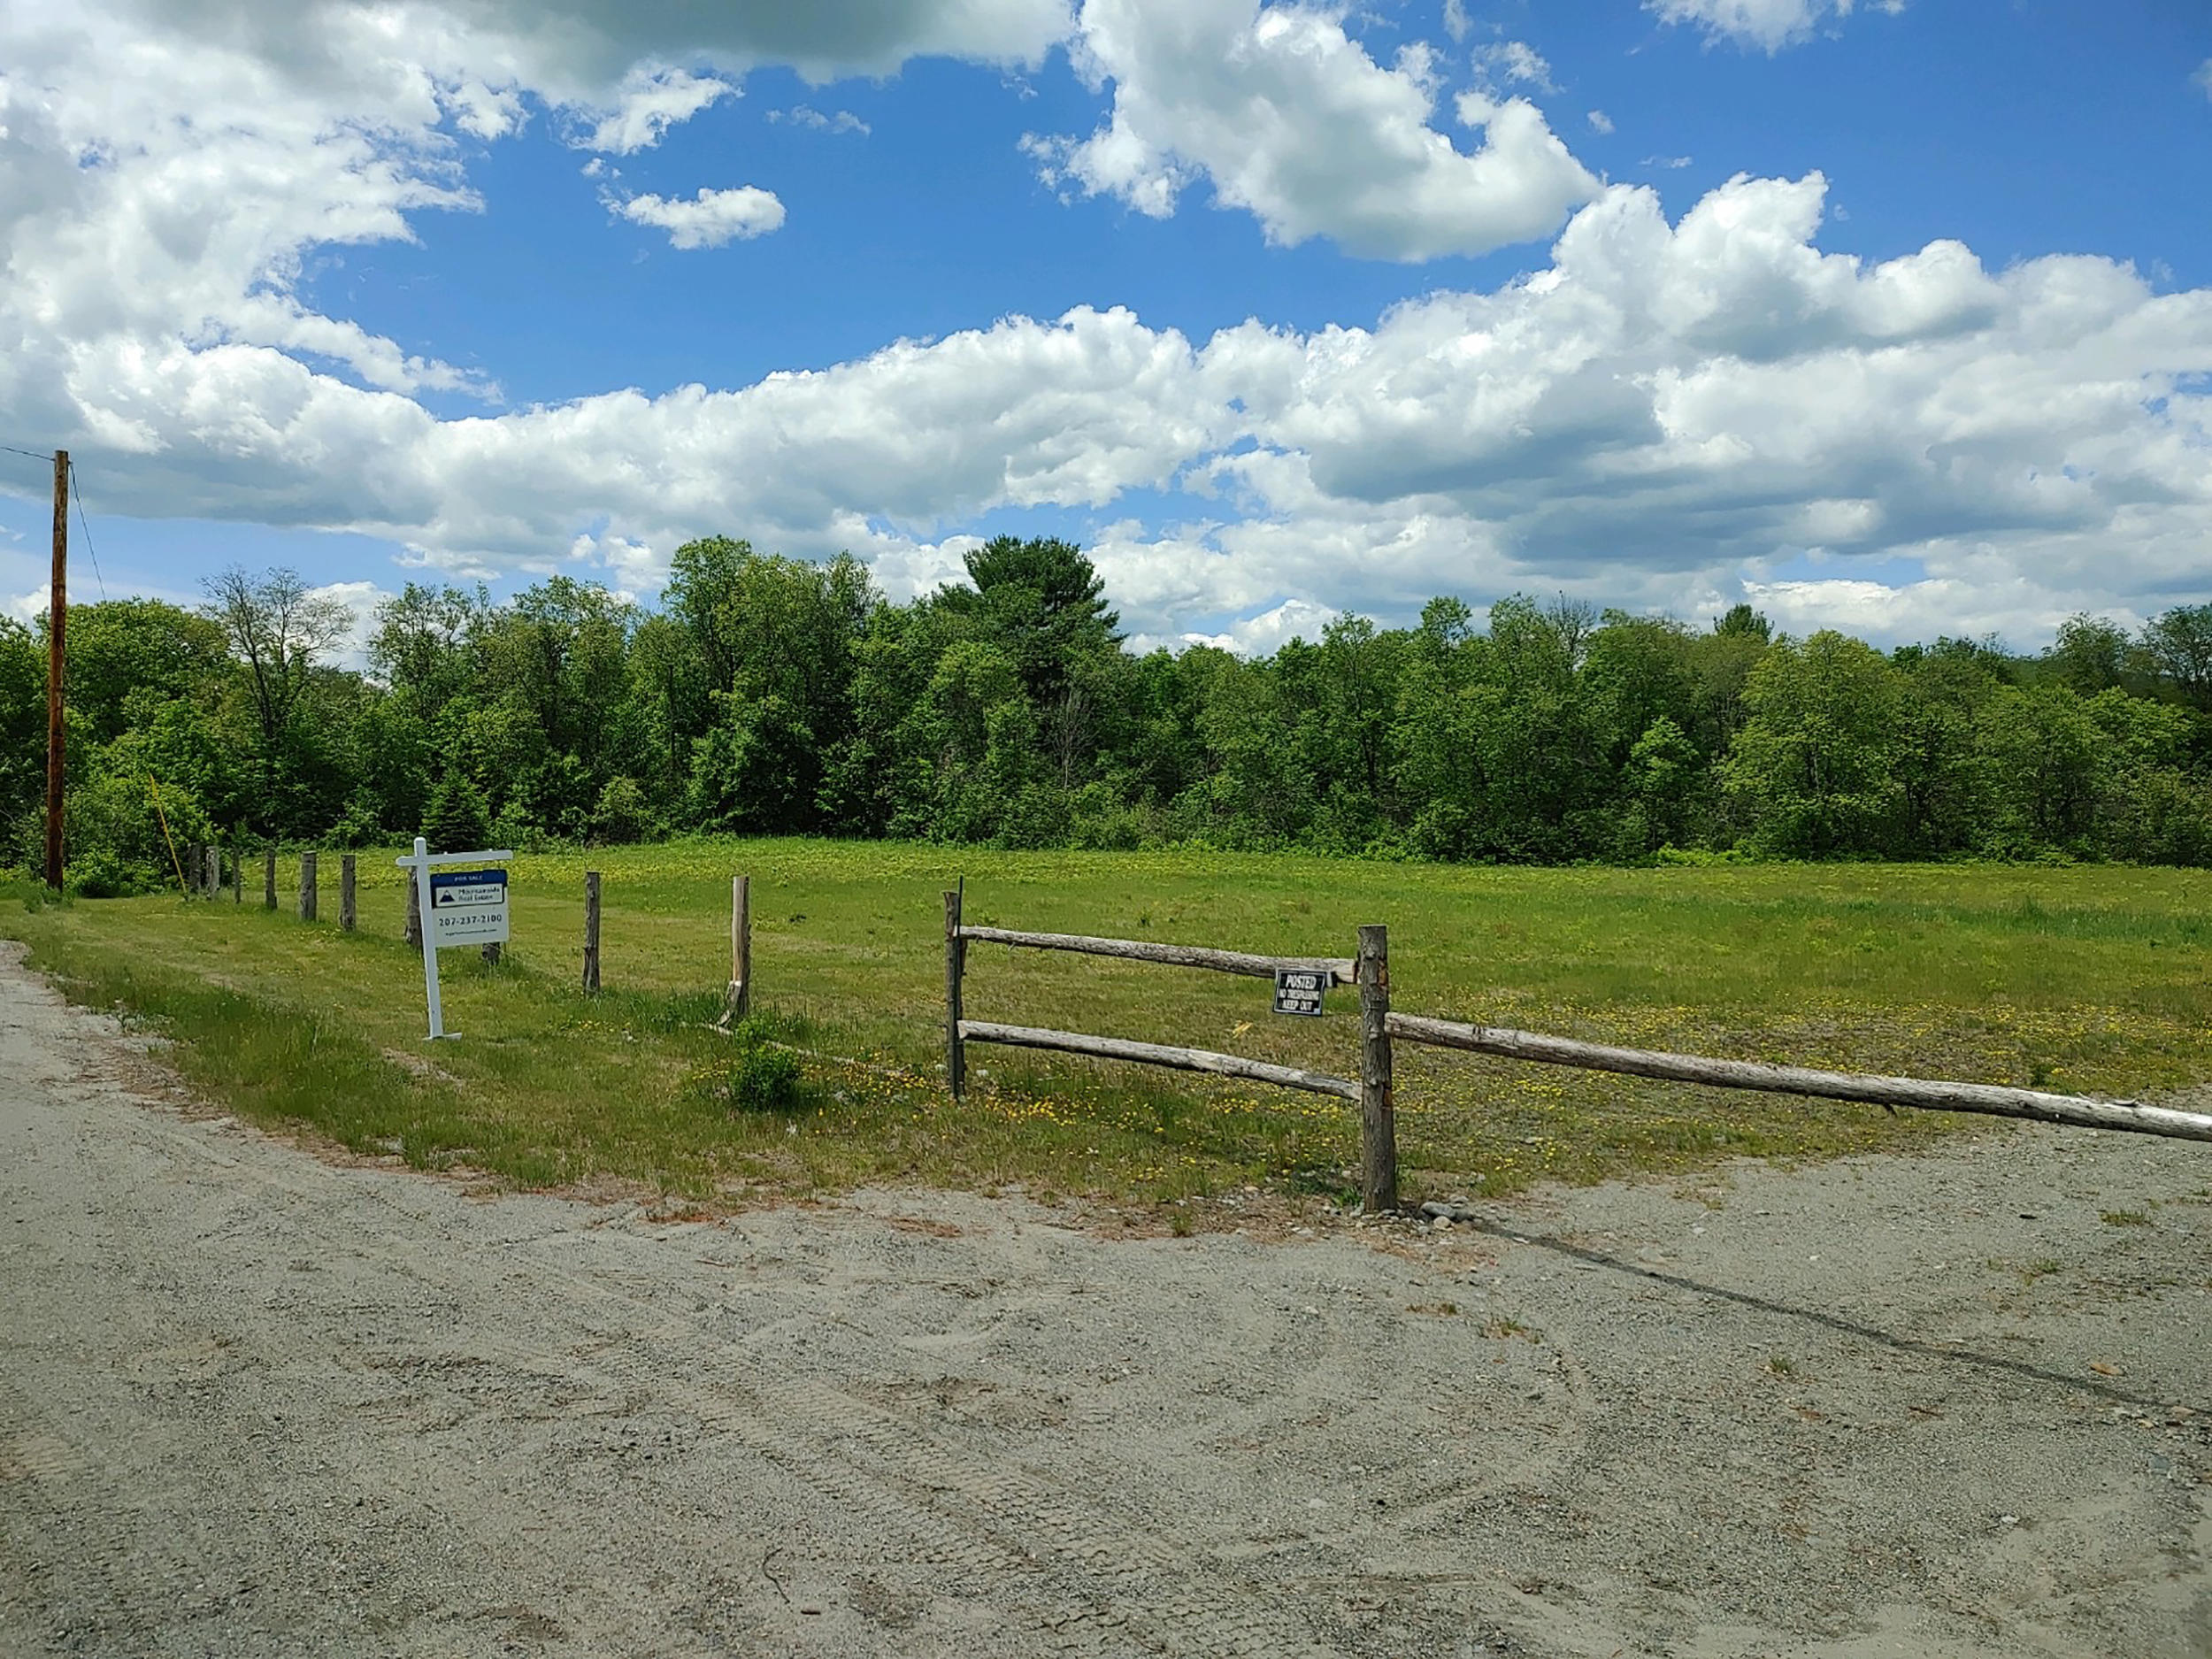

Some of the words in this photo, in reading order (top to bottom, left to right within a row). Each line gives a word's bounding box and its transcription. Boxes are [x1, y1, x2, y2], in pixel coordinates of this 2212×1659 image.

[439, 914, 502, 926] 207-237-2100
[1286, 974, 1317, 989] POSTED
[1279, 988, 1287, 998] NO
[1287, 988, 1320, 1001] TRESPASSING
[1282, 1000, 1299, 1010] KEEP
[1300, 1001, 1313, 1010] OUT
